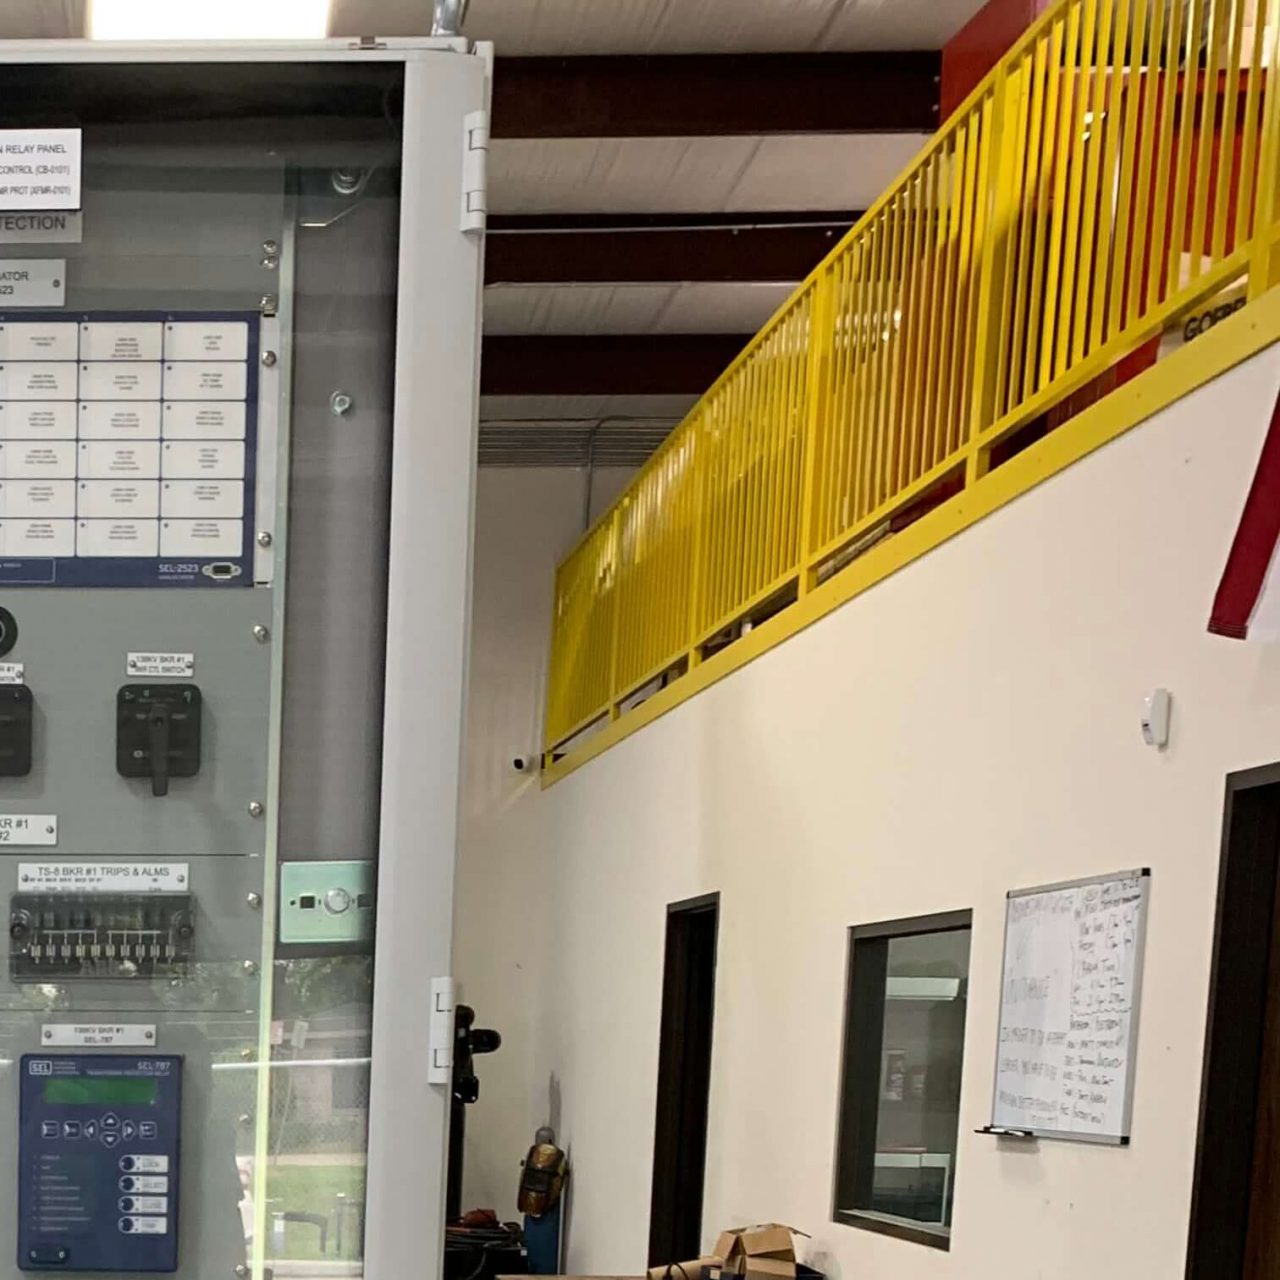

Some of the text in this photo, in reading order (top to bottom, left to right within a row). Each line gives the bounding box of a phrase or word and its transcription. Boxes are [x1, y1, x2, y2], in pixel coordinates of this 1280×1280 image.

[6, 144, 34, 154] RELAY
[37, 144, 67, 154] PANEL
[16, 819, 28, 829] #1
[38, 867, 170, 877] TS-8 BKR #1 TRIPS & ALMS
[31, 1063, 50, 1072] SEL
